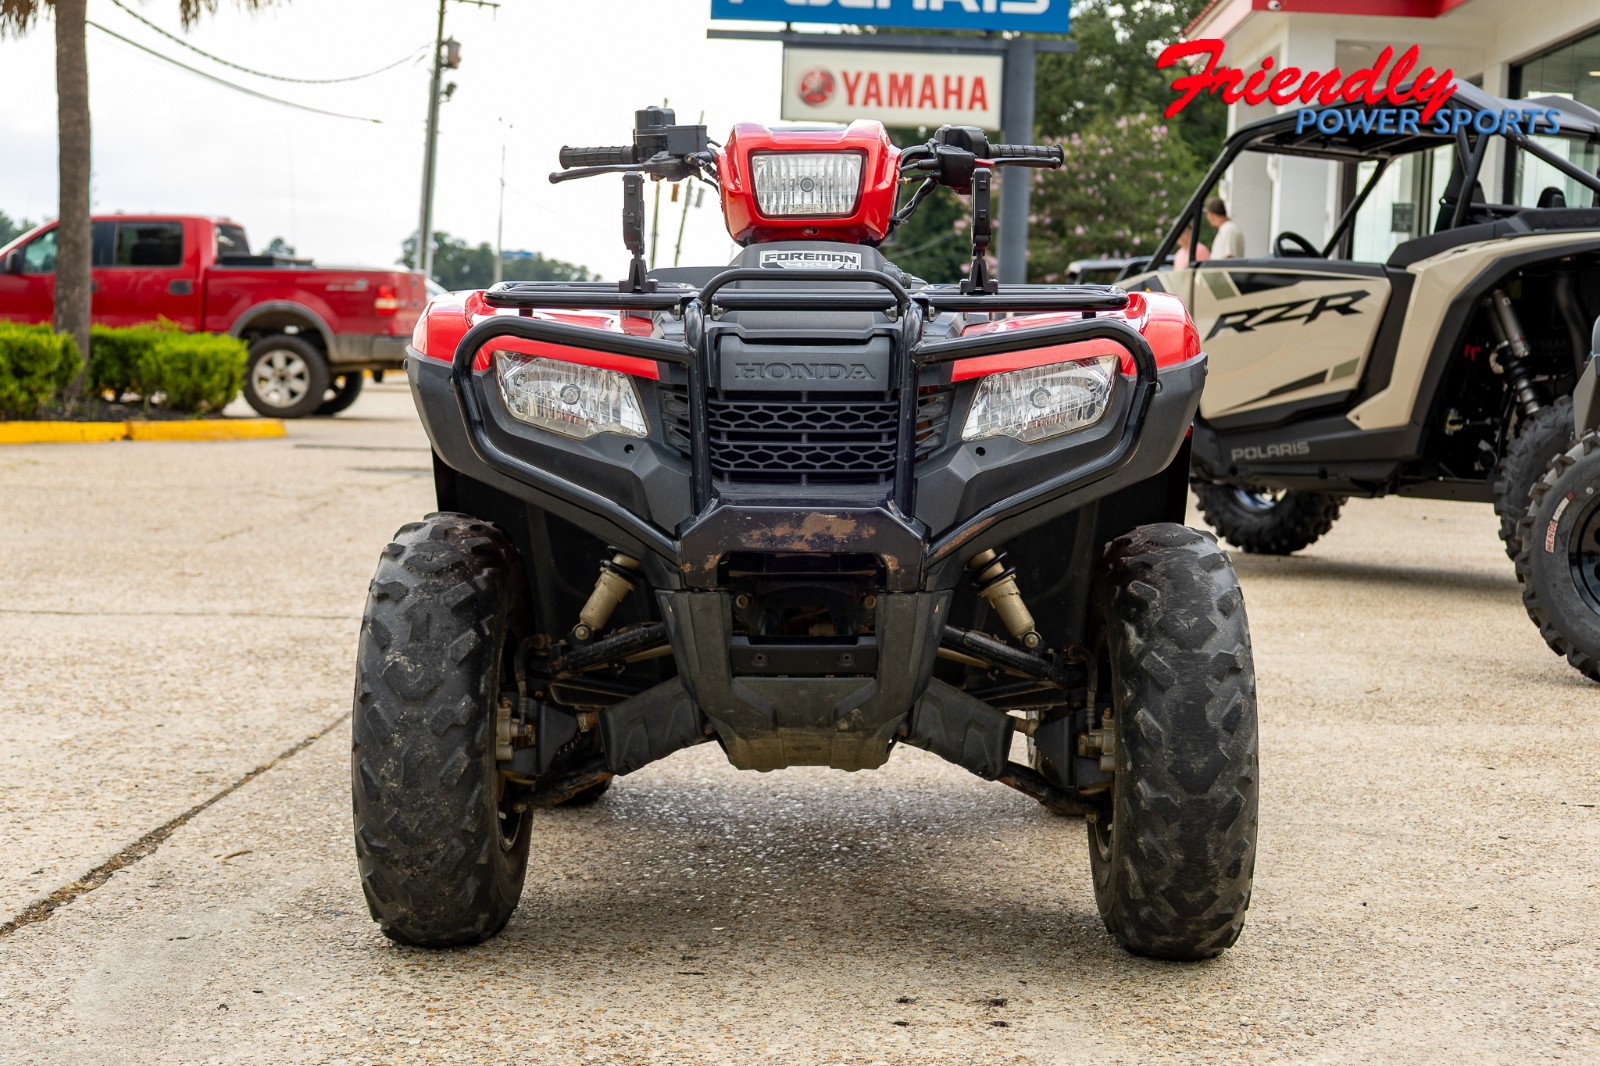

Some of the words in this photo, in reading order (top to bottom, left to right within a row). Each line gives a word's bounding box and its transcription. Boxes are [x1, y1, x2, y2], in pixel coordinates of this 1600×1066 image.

[841, 70, 989, 111] YAMAHA
[765, 253, 856, 263] FOREMAN
[1204, 290, 1371, 343] RZR
[735, 363, 876, 380] HONDA
[1231, 441, 1310, 462] POLARIS
[1545, 520, 1558, 553] KENDA
